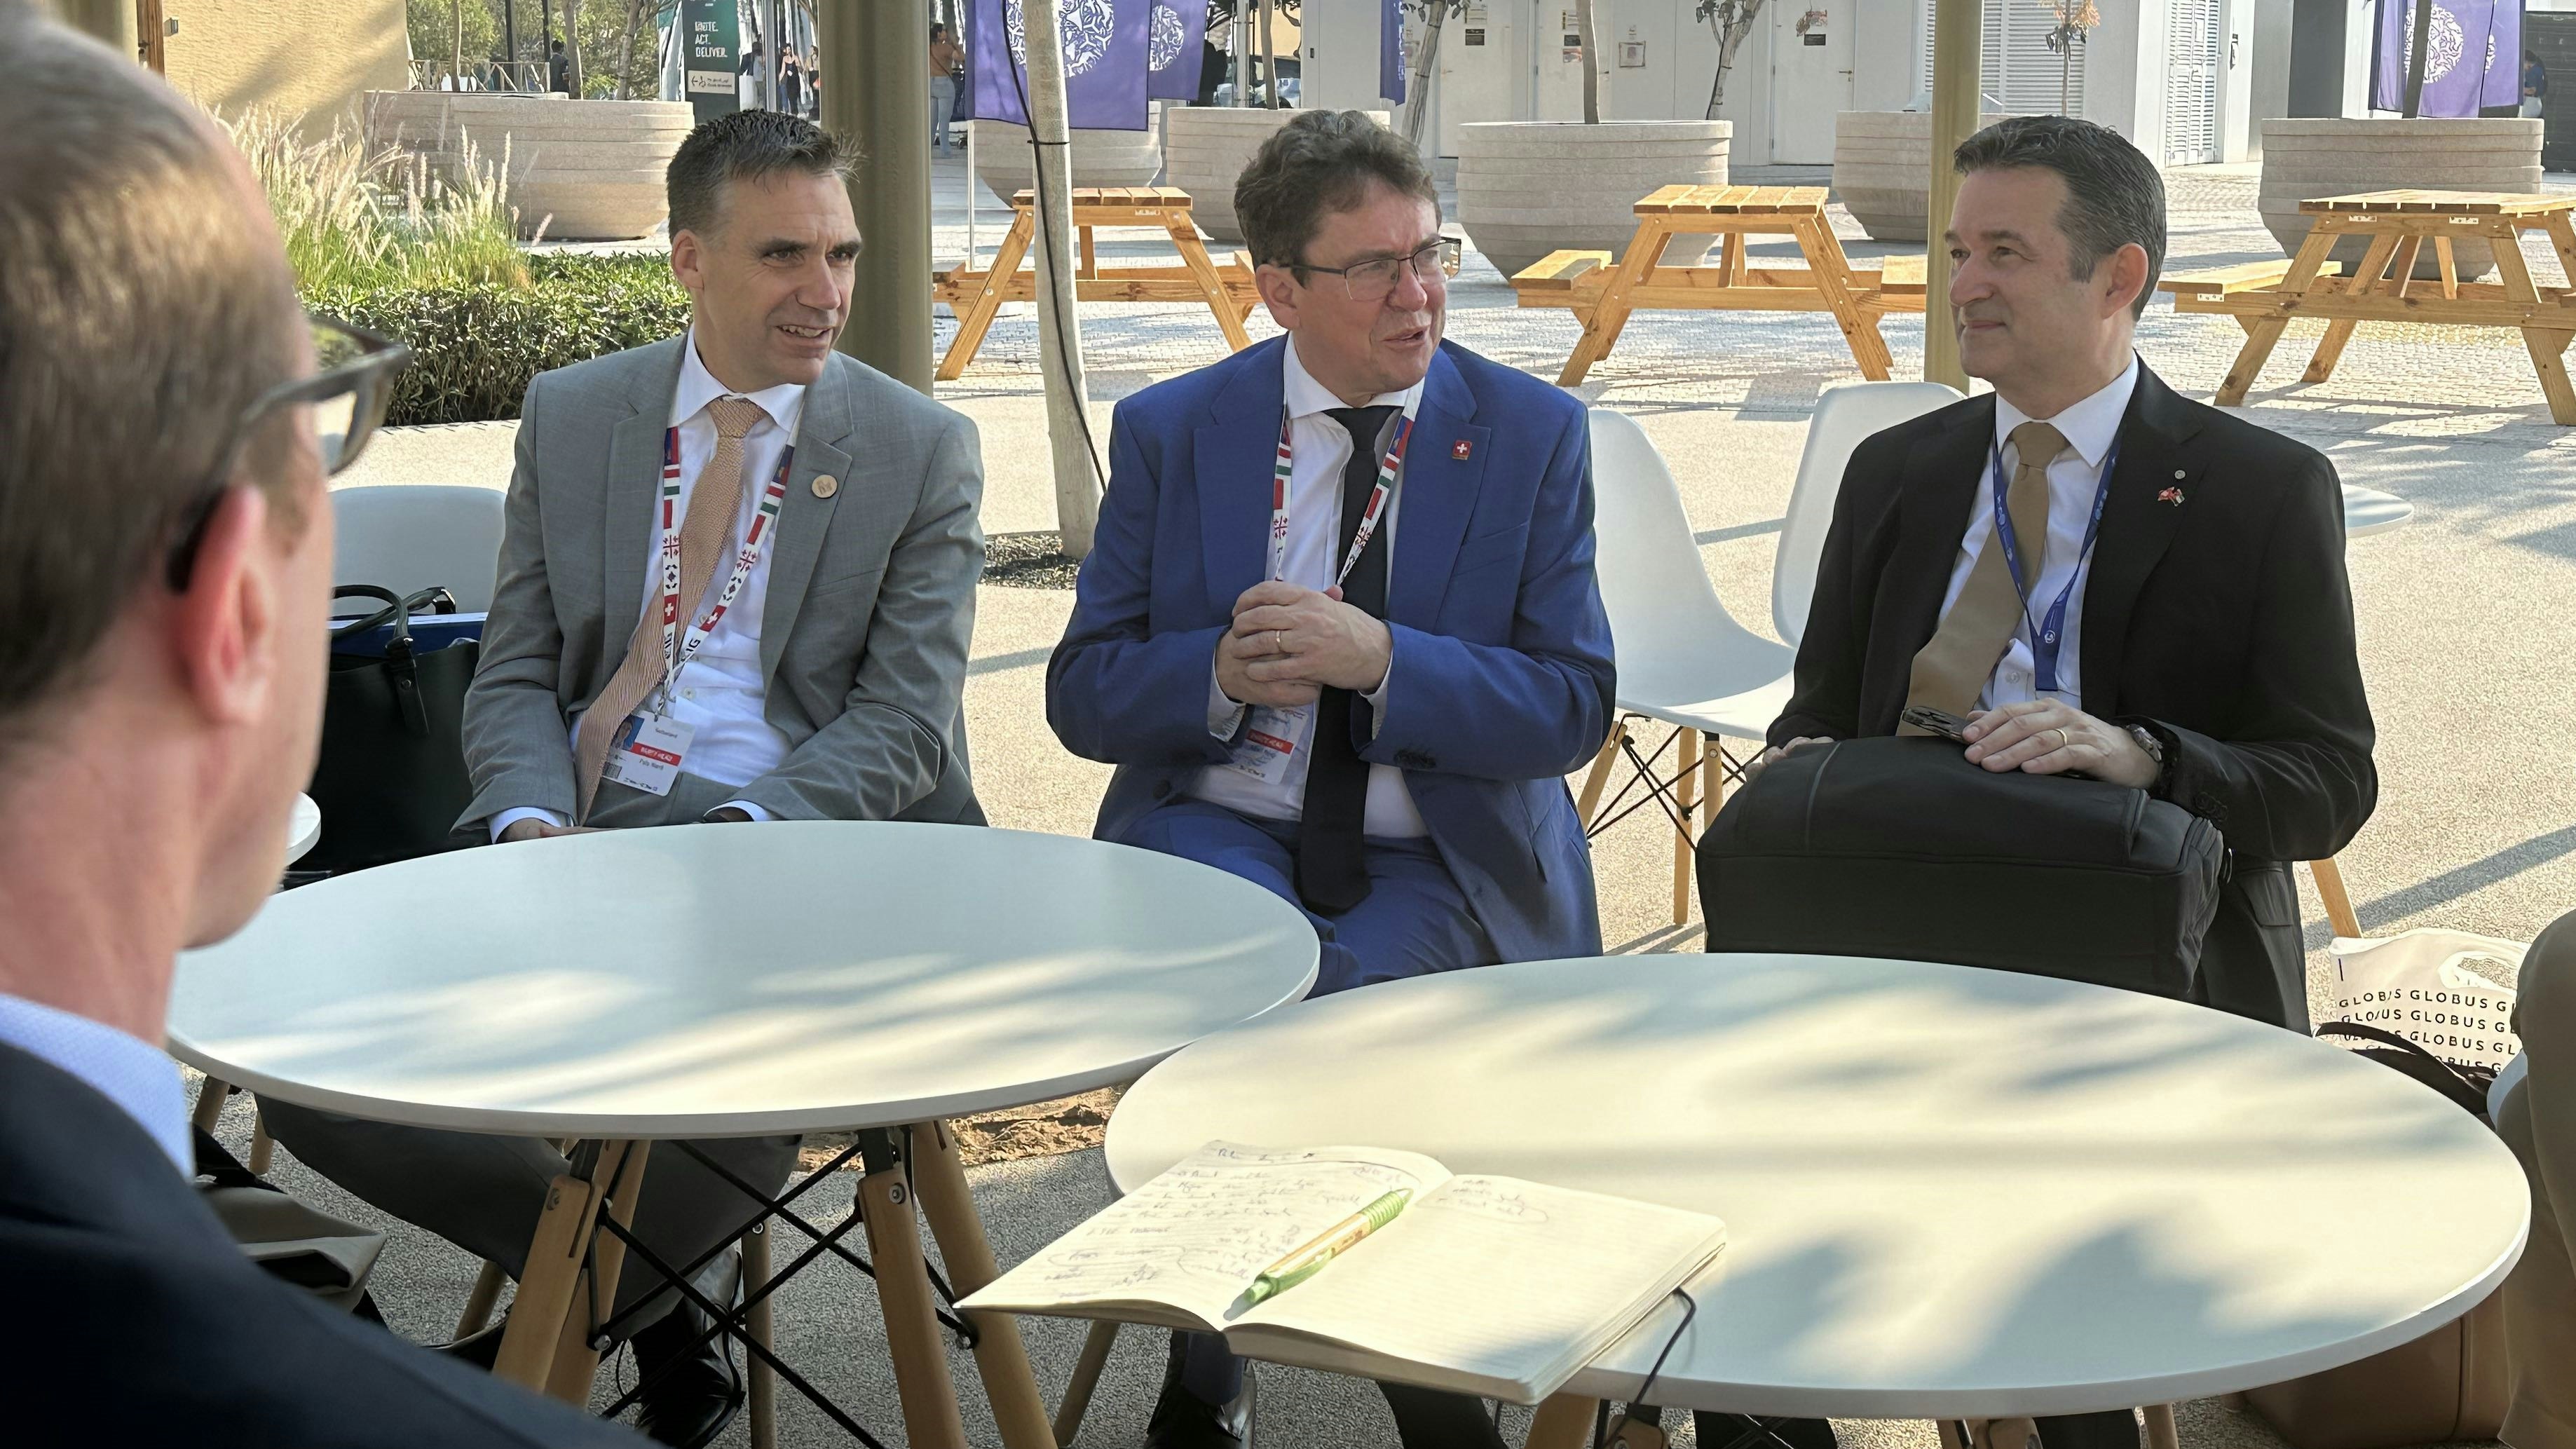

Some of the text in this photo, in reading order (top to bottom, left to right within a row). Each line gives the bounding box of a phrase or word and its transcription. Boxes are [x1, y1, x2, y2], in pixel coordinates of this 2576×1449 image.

[2410, 989, 2488, 1009] GLOBUS
[2341, 1009, 2402, 1023] GLOUS
[2410, 1009, 2486, 1030] GLOBUS
[2409, 1030, 2485, 1052] GLOBUS
